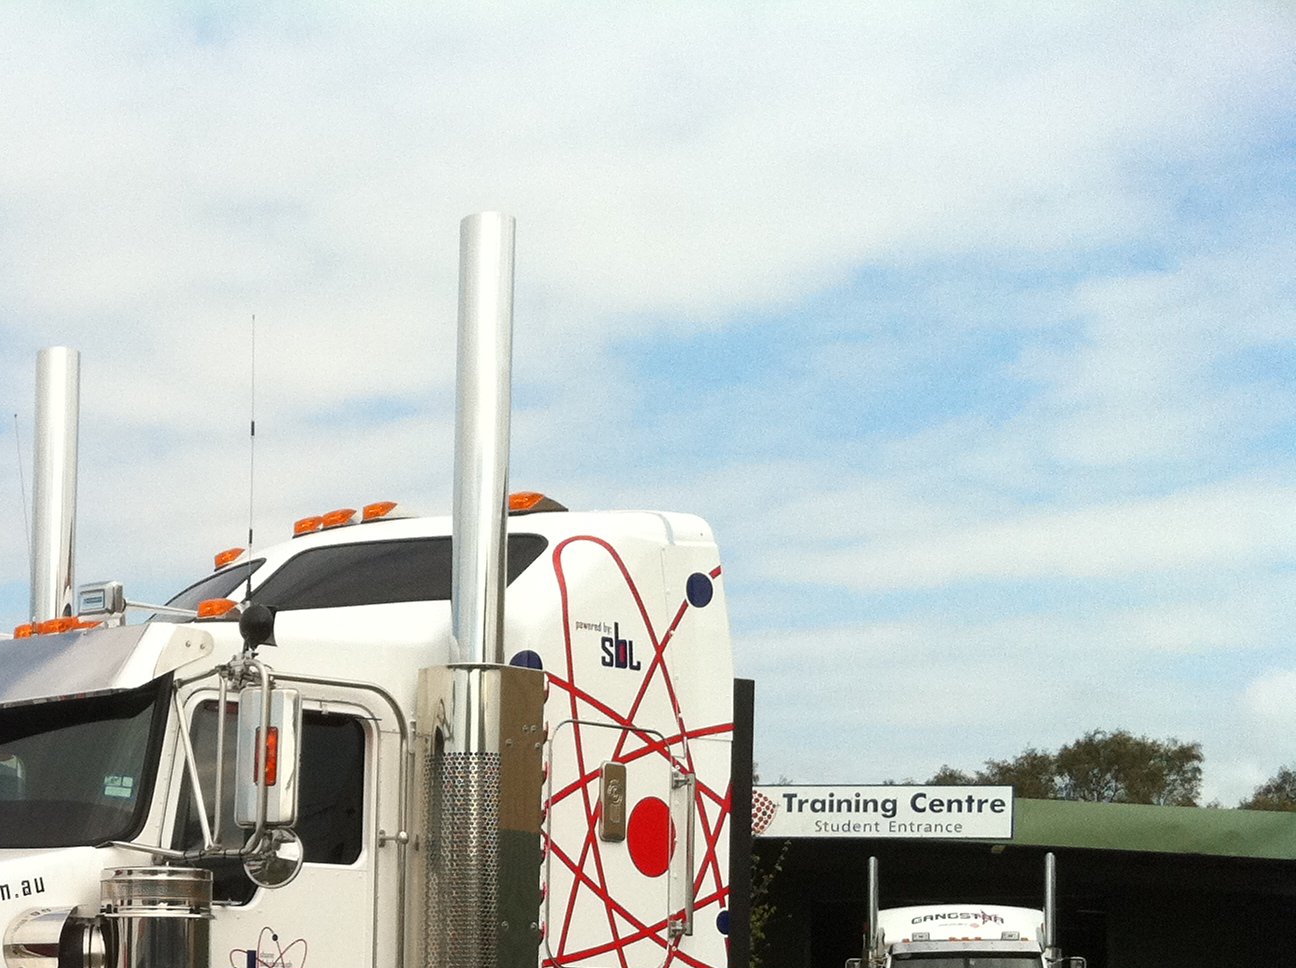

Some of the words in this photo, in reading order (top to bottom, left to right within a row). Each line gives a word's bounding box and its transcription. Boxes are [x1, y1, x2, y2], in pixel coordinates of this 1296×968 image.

[782, 792, 897, 818] Training
[910, 792, 1006, 813] Centre
[815, 820, 880, 833] Student
[889, 820, 963, 833] Entrance
